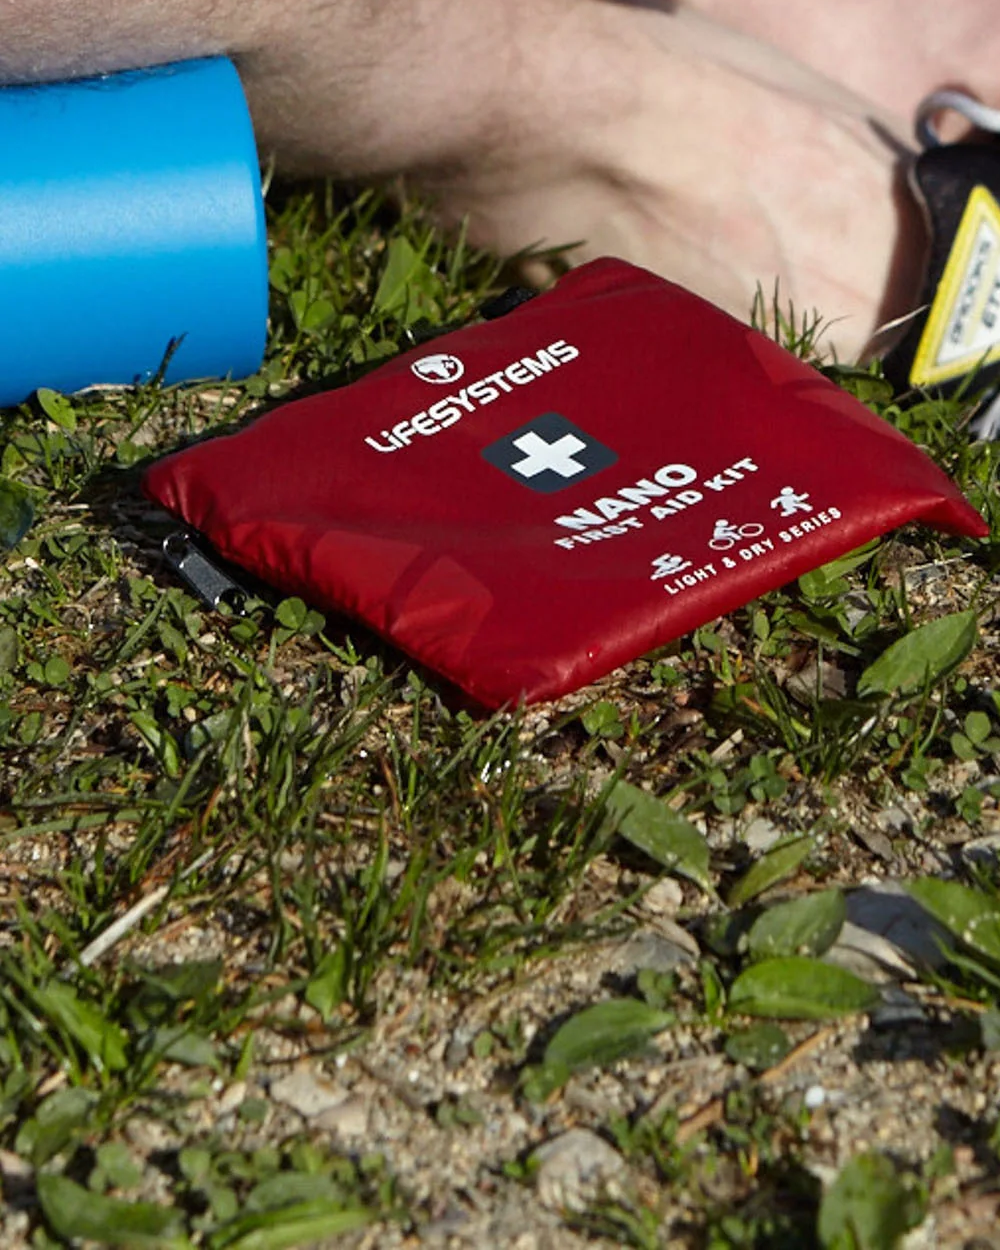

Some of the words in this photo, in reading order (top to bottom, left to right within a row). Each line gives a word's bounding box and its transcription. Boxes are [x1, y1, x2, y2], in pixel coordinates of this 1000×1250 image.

[553, 516, 644, 550] FIRST
[650, 489, 704, 521] AID
[703, 457, 759, 492] KIT
[554, 463, 698, 534] NANO
[664, 563, 717, 595] LIGHT
[721, 556, 737, 569] &
[738, 538, 774, 561] DRY
[778, 507, 842, 543] SERIES
